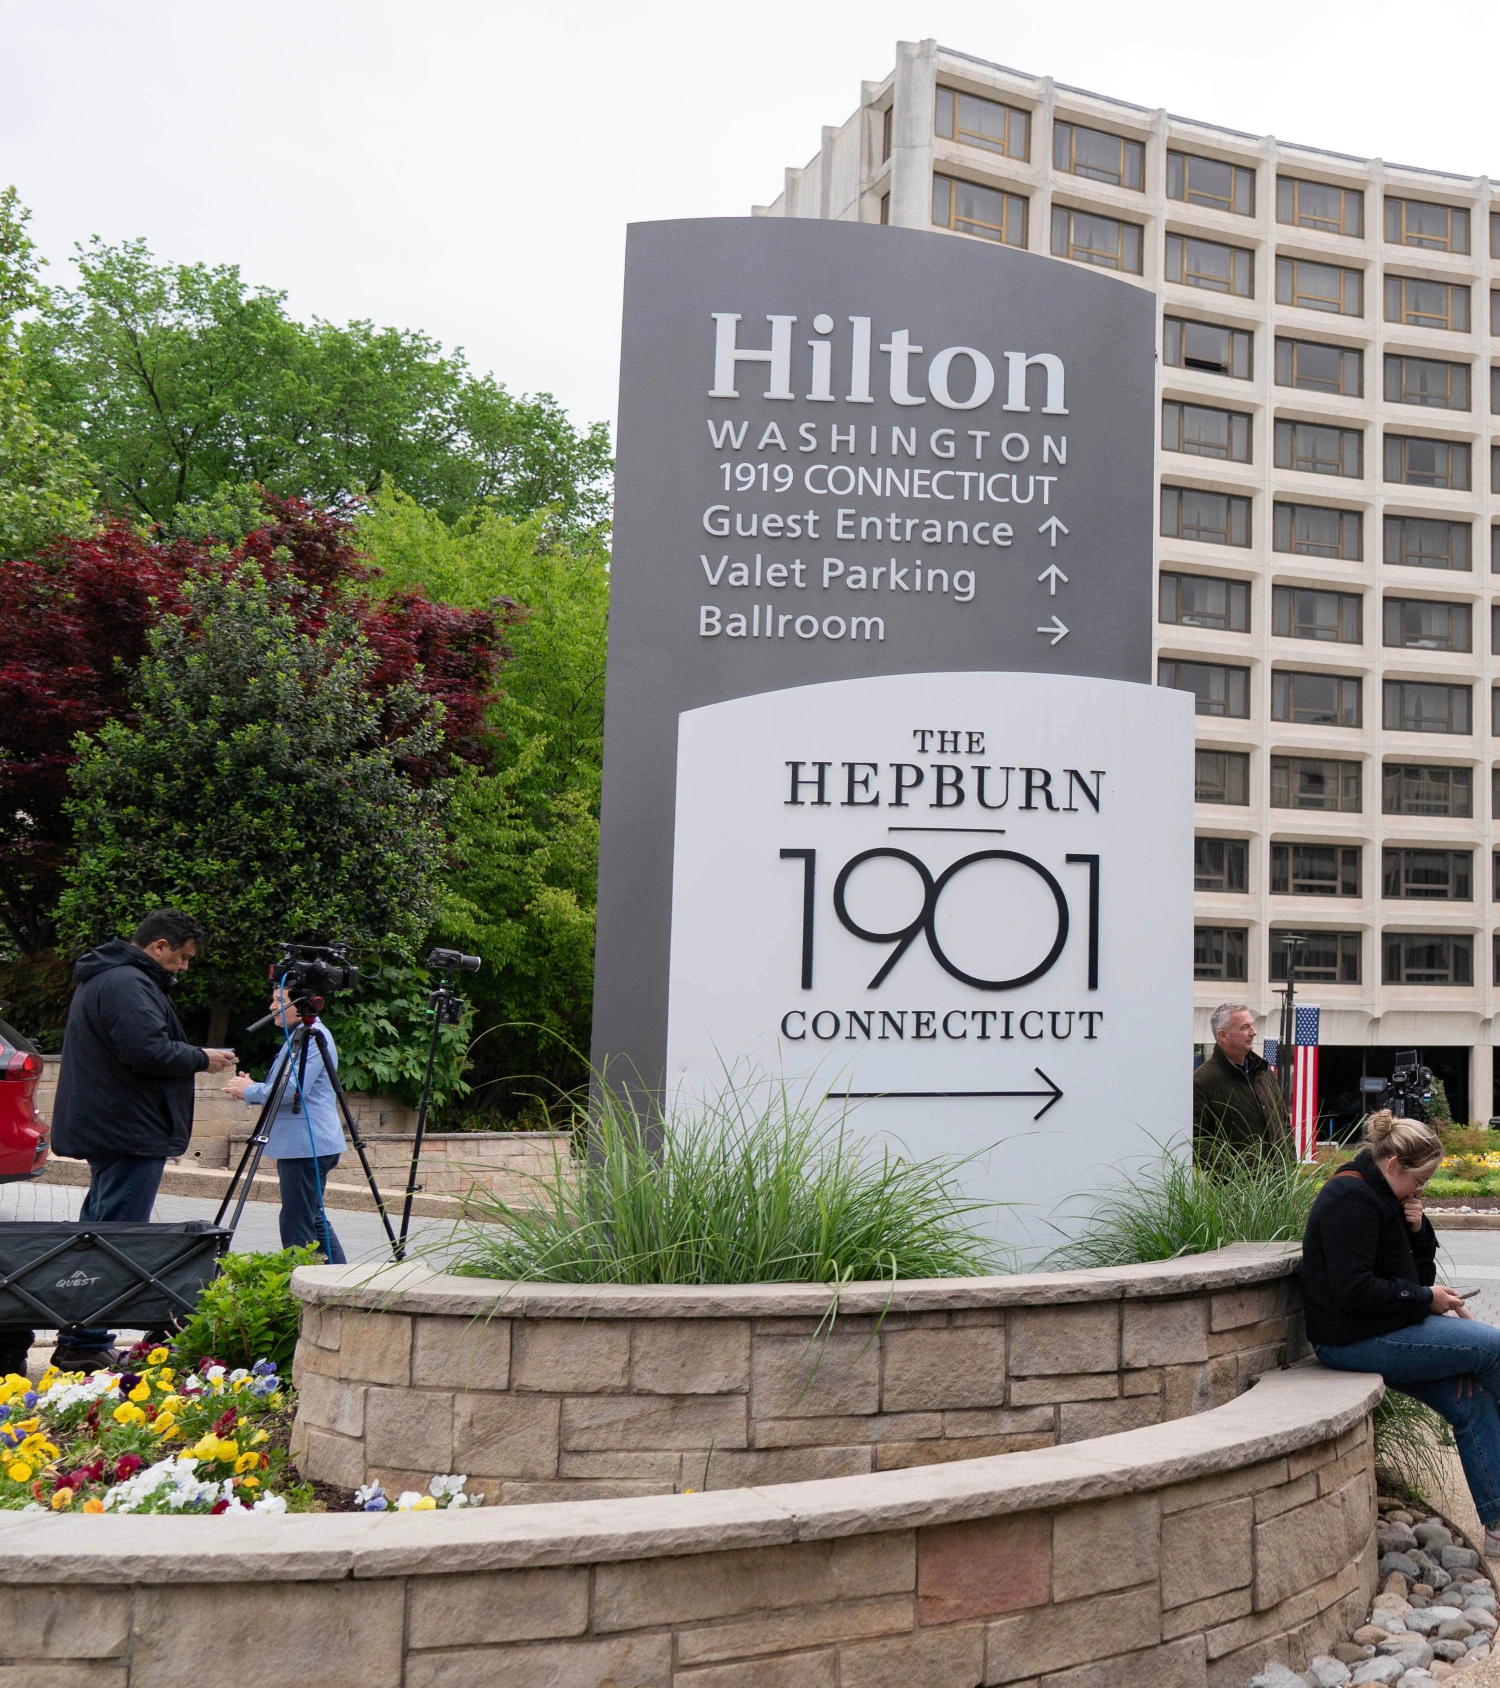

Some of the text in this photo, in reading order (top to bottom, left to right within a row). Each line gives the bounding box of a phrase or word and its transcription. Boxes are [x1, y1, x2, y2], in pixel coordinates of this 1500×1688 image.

[708, 312, 1070, 415] Hilton
[706, 419, 1067, 465] WASHINGTON
[719, 462, 1058, 504] 1919 CONNECTICUT
[702, 505, 1014, 547] Guest Entrance
[700, 553, 977, 602] Valet Parking
[699, 604, 886, 641] Ballroom
[913, 729, 986, 754] THE
[784, 761, 1106, 813] HEPBURN
[779, 847, 1100, 991] 1901
[781, 1010, 1103, 1040] CONNECTICUT
[56, 1277, 100, 1288] QUEST
